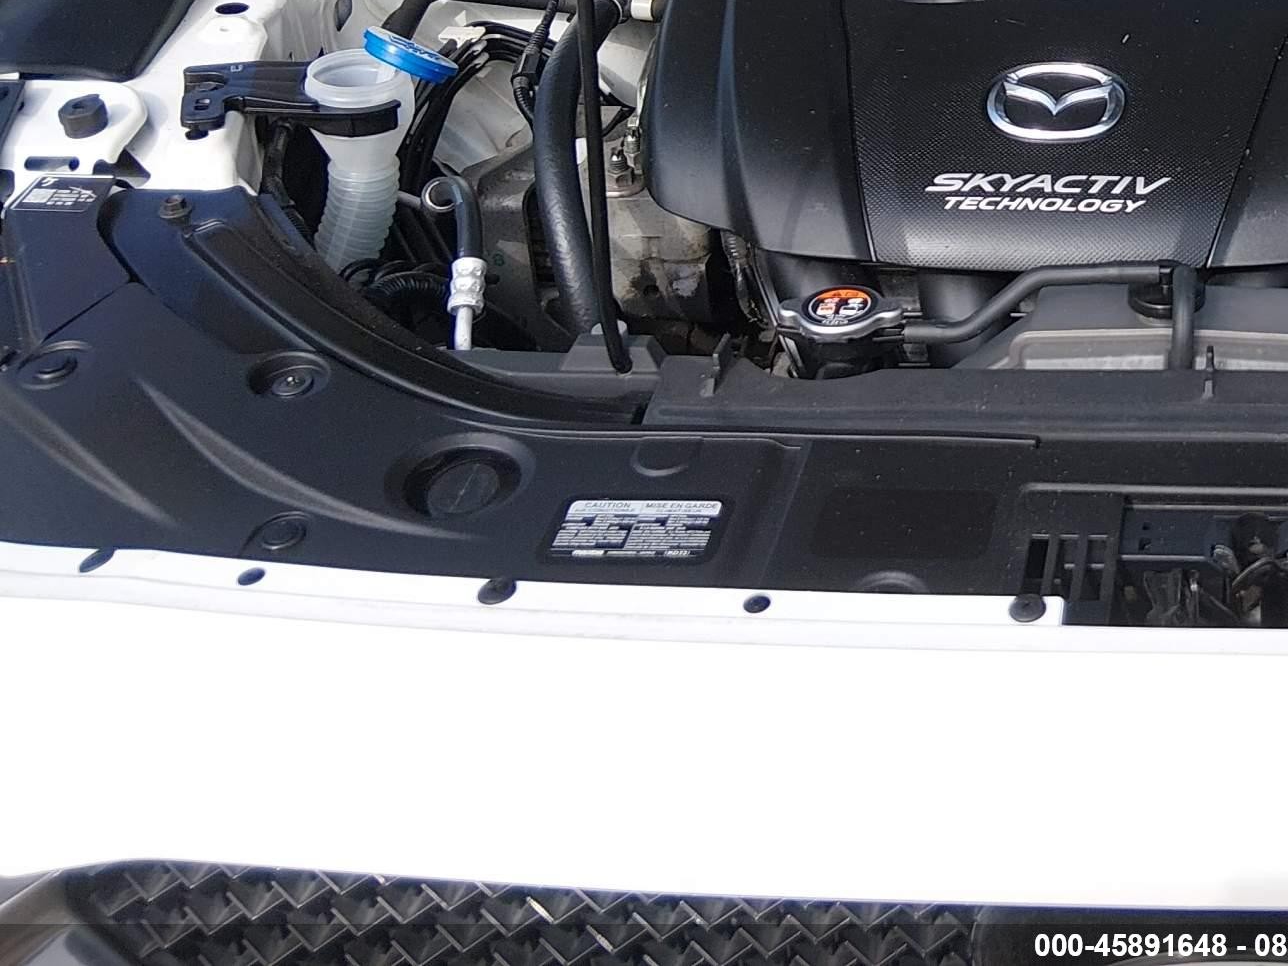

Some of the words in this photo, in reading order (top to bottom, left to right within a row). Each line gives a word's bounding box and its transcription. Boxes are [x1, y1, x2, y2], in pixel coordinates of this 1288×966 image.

[925, 173, 1171, 195] SKYACTIV
[943, 196, 1146, 213] TECHNOLOGY
[584, 501, 631, 509] CAUTION
